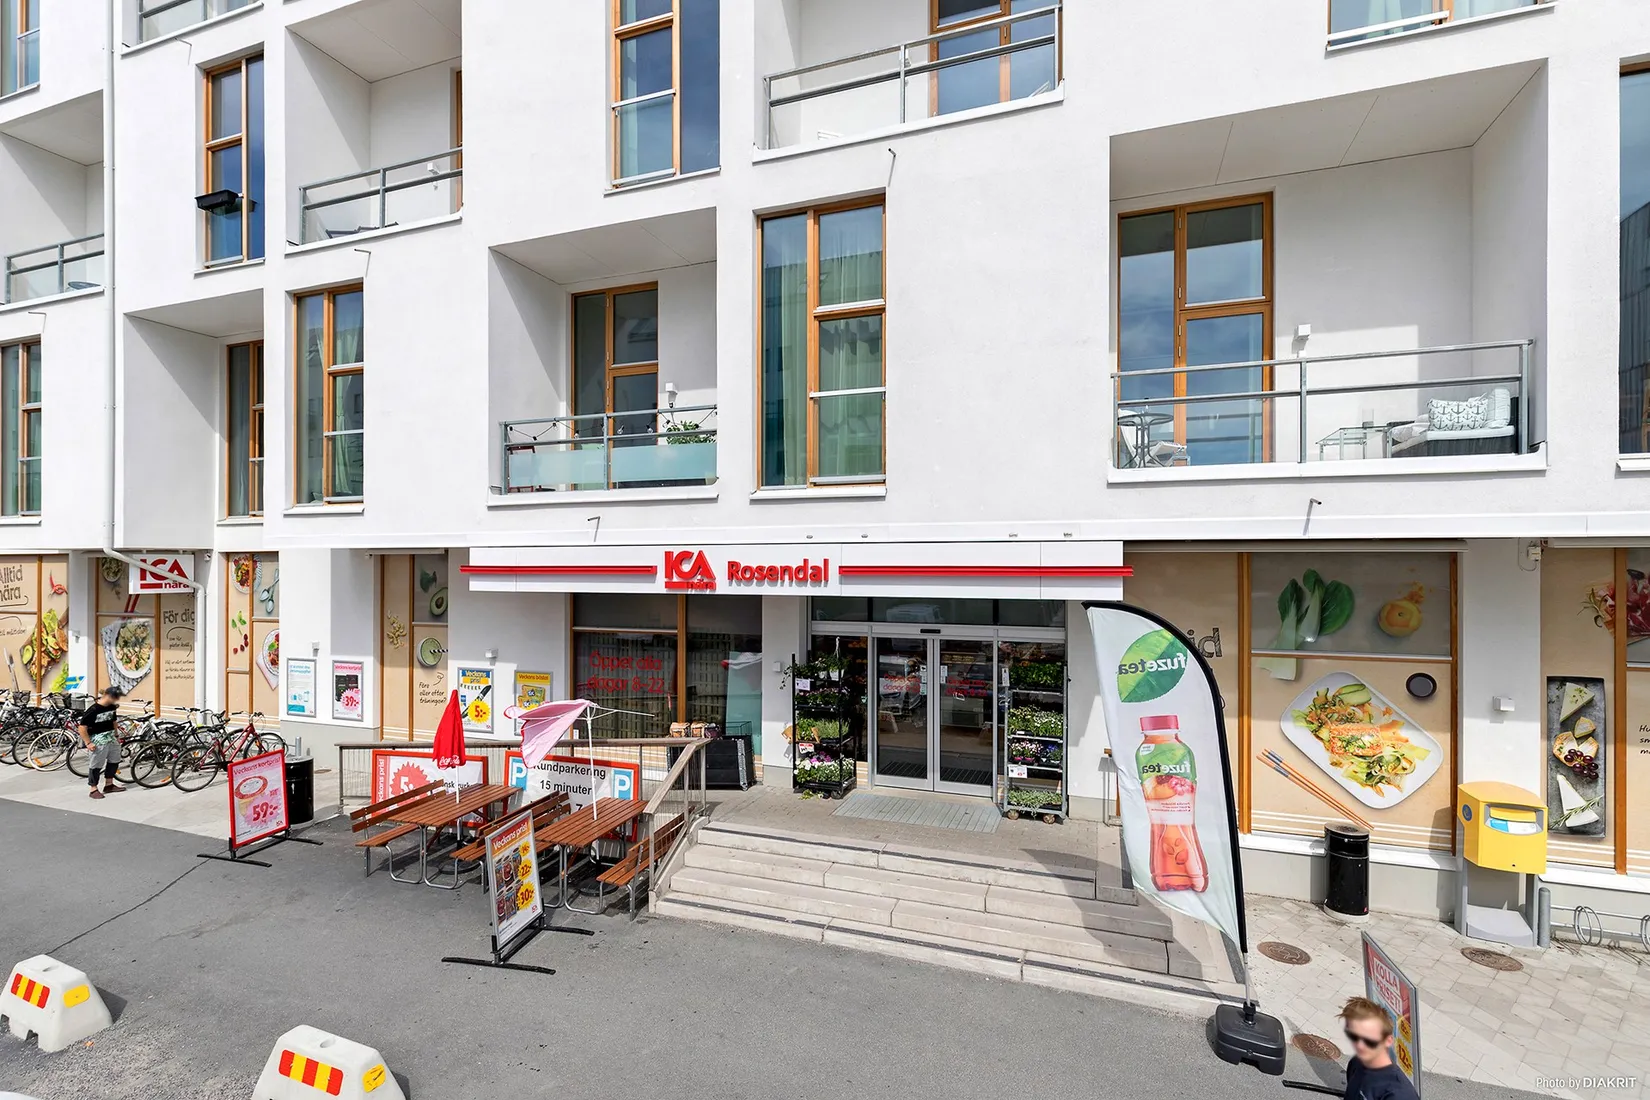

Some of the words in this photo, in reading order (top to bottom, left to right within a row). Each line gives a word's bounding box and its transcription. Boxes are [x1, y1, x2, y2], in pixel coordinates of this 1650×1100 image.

[140, 558, 189, 581] ICA
[664, 550, 716, 580] ICA
[727, 558, 829, 582] Rosendal
[164, 580, 190, 589] nära
[163, 610, 179, 624] För
[589, 650, 634, 672] Öppet
[635, 655, 662, 671] alla
[587, 674, 629, 694] dagar
[631, 676, 665, 694] 8-22
[475, 705, 487, 718] 5:-
[540, 780, 551, 790] 15
[553, 782, 592, 795] minuter
[252, 801, 278, 822] 59:-
[493, 830, 515, 850] Veckans
[515, 822, 528, 838] pris!
[1375, 960, 1399, 991] KOLLA
[1375, 978, 1401, 1012] PRISET!
